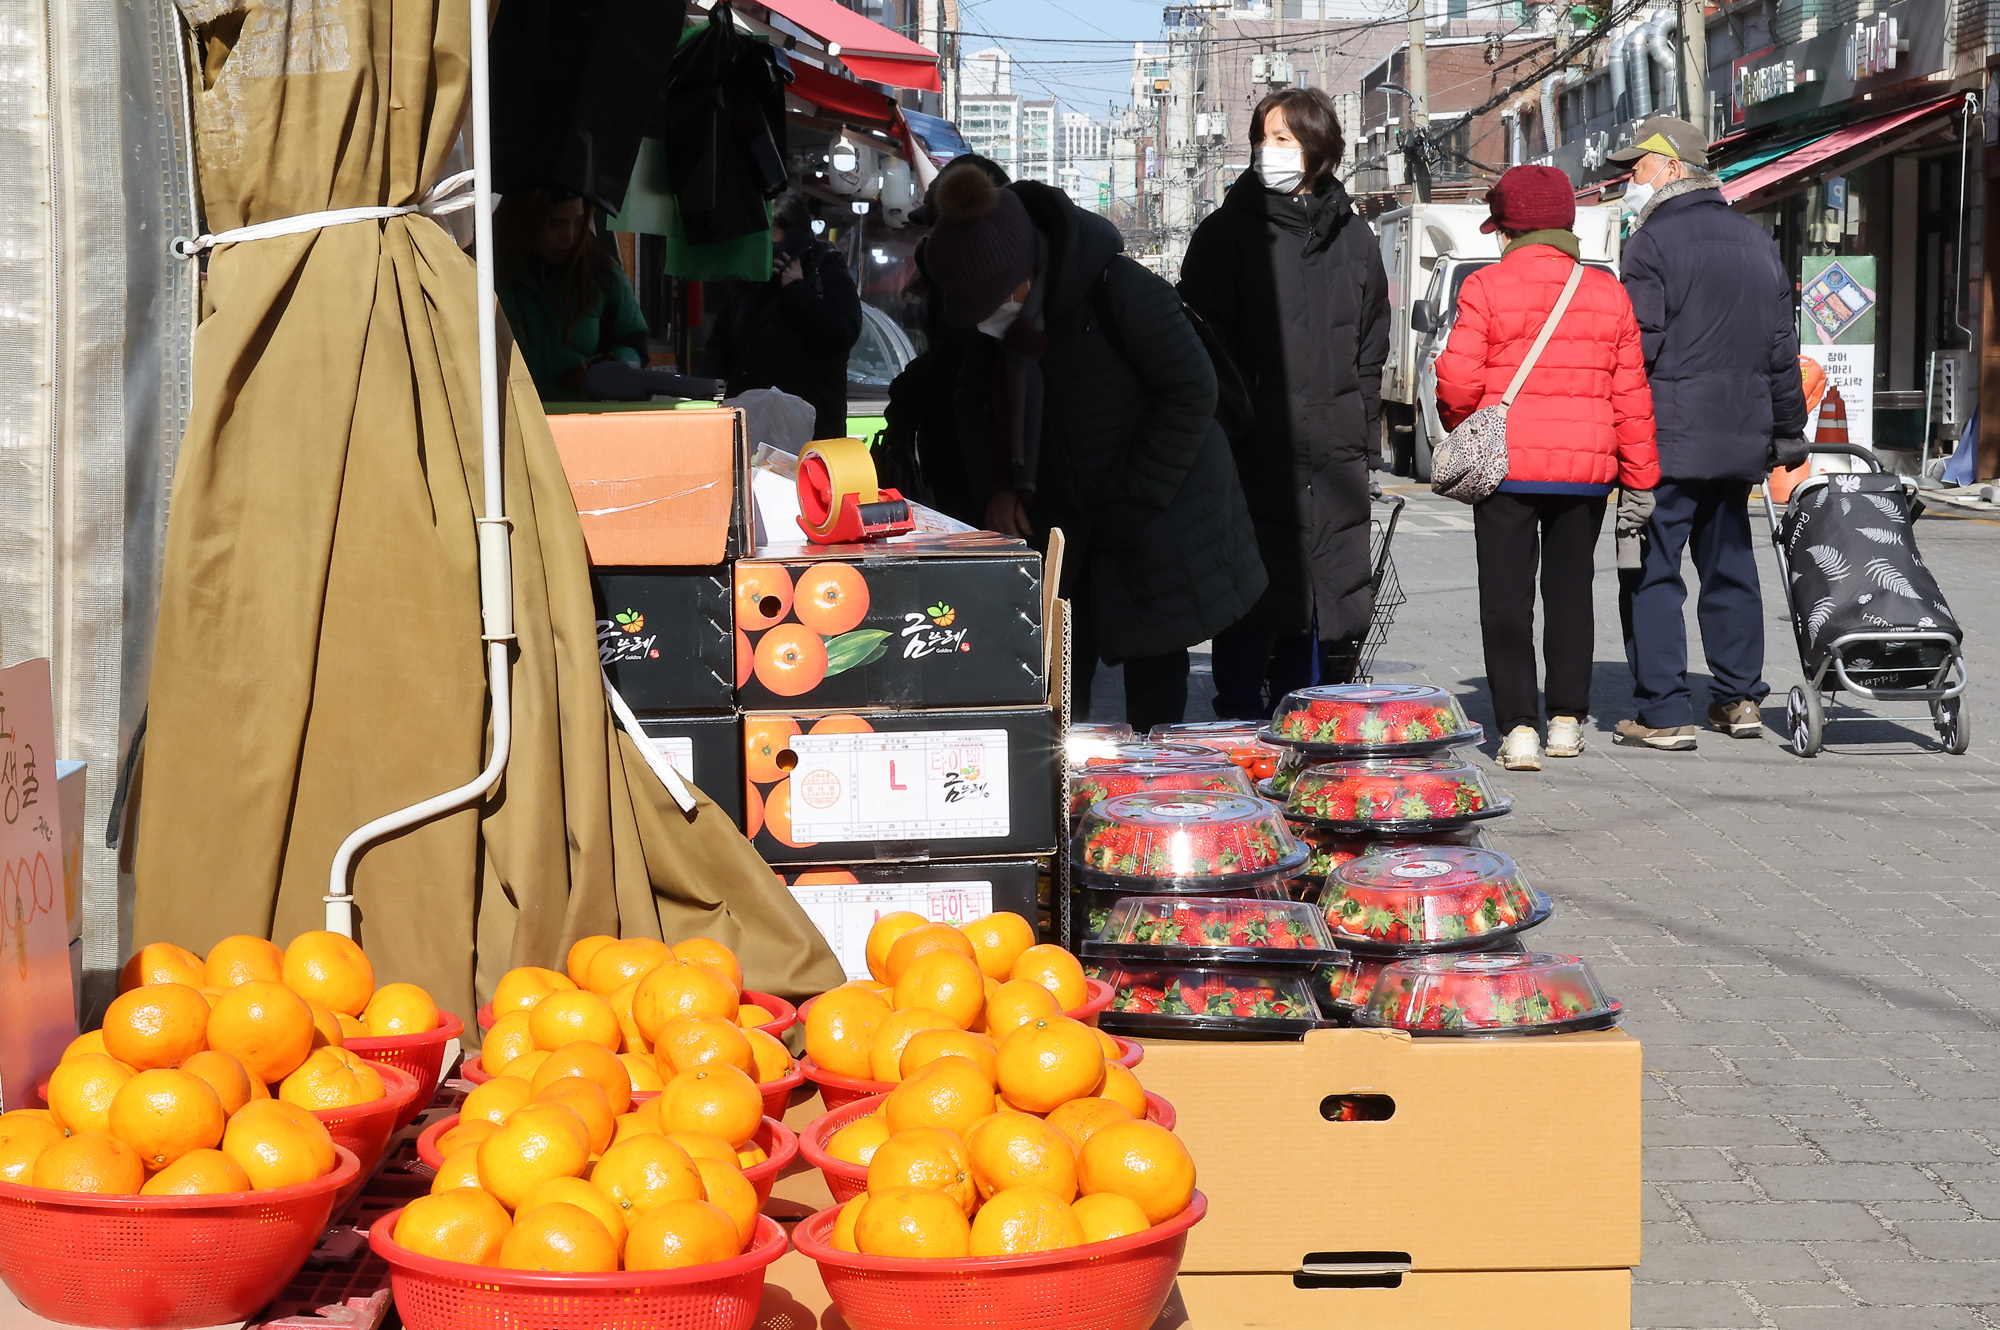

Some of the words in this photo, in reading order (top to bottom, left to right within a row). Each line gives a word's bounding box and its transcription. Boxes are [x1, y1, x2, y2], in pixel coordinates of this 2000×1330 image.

[1827, 352, 1847, 362] 장어
[1823, 365, 1852, 375] 한마리
[890, 759, 908, 791] L
